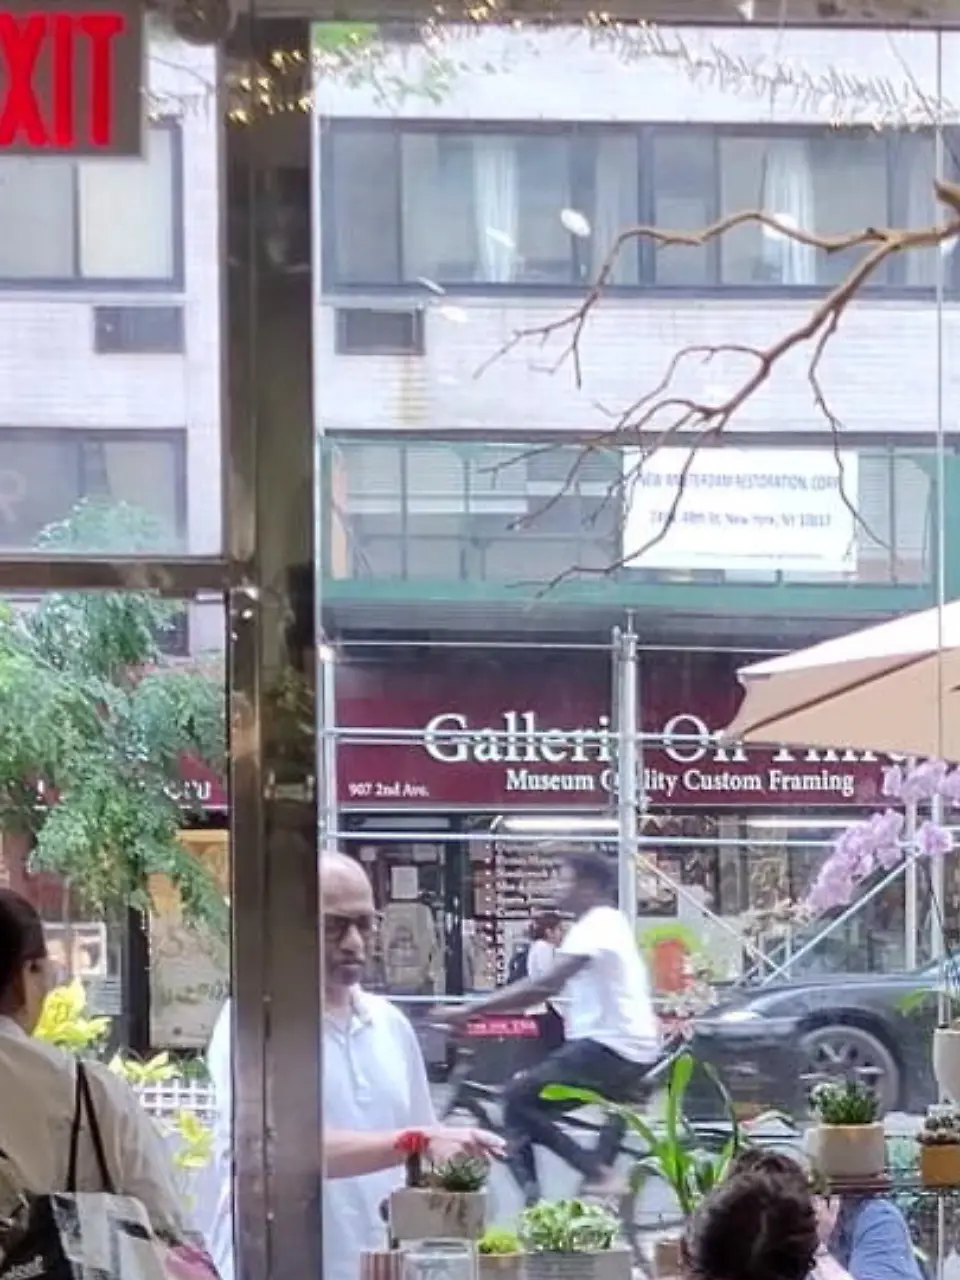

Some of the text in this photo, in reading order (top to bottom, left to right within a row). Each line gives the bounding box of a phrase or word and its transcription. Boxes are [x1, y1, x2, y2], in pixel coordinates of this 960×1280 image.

[666, 473, 733, 488] AMTERDAM
[423, 711, 619, 762] Galleri
[348, 782, 430, 797] 907 2nd Ave.
[506, 769, 855, 797] Museum Qlity Custom Framing
